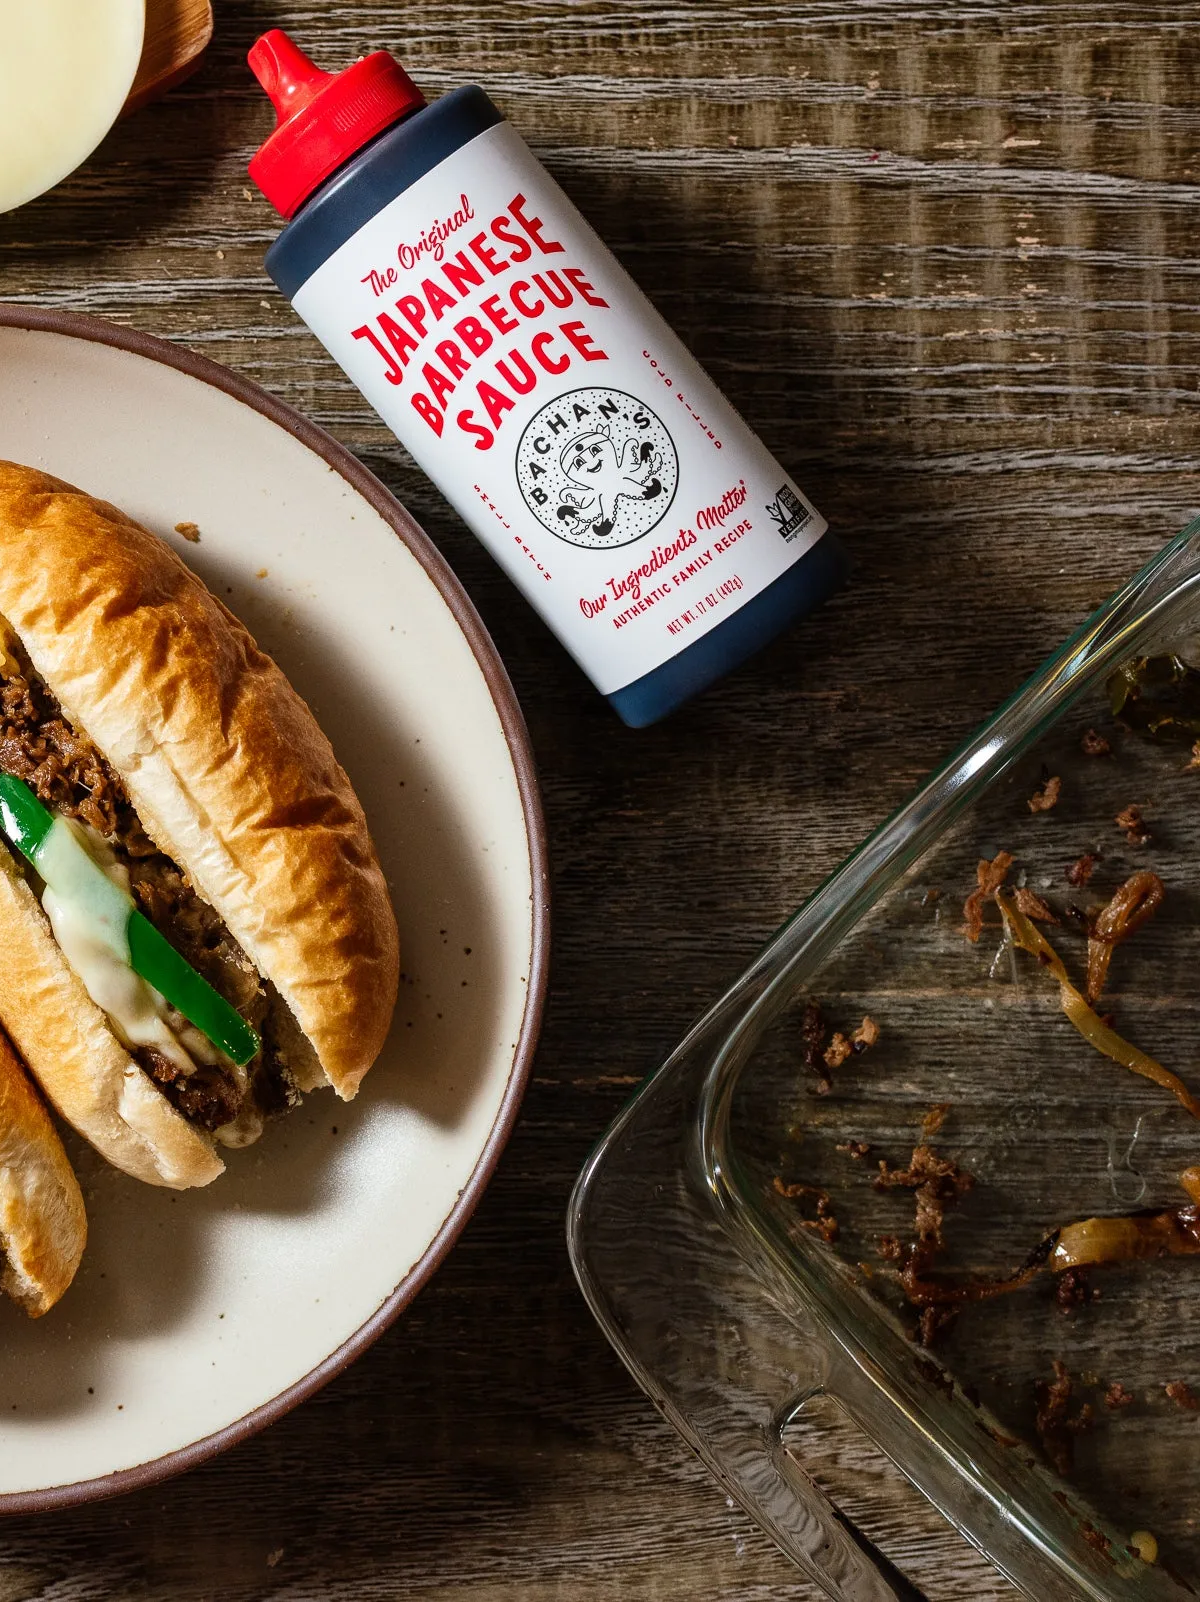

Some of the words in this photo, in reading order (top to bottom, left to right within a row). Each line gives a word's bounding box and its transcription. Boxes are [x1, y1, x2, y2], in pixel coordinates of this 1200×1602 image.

[351, 192, 566, 386] JAPANESE
[361, 267, 398, 297] The
[398, 193, 474, 270] Original
[411, 268, 611, 439] BARBECUE
[456, 320, 609, 451] SAUCE
[642, 350, 673, 387] COLD
[677, 393, 722, 449] FILLED
[529, 397, 651, 506] BACHAN'S
[474, 484, 511, 529] SMALL
[514, 536, 552, 581] BATCH
[781, 508, 808, 535] VERIFIED
[579, 594, 608, 619] Our
[606, 529, 698, 600] Ingredients
[612, 583, 672, 629] AUTHENTIC
[672, 550, 713, 586] FAMILY
[714, 519, 752, 554] RECIPE
[666, 619, 684, 636] NET
[681, 610, 699, 625] WT.
[695, 602, 708, 615] 17
[705, 593, 719, 608] OZ
[716, 574, 744, 600] (482g)
